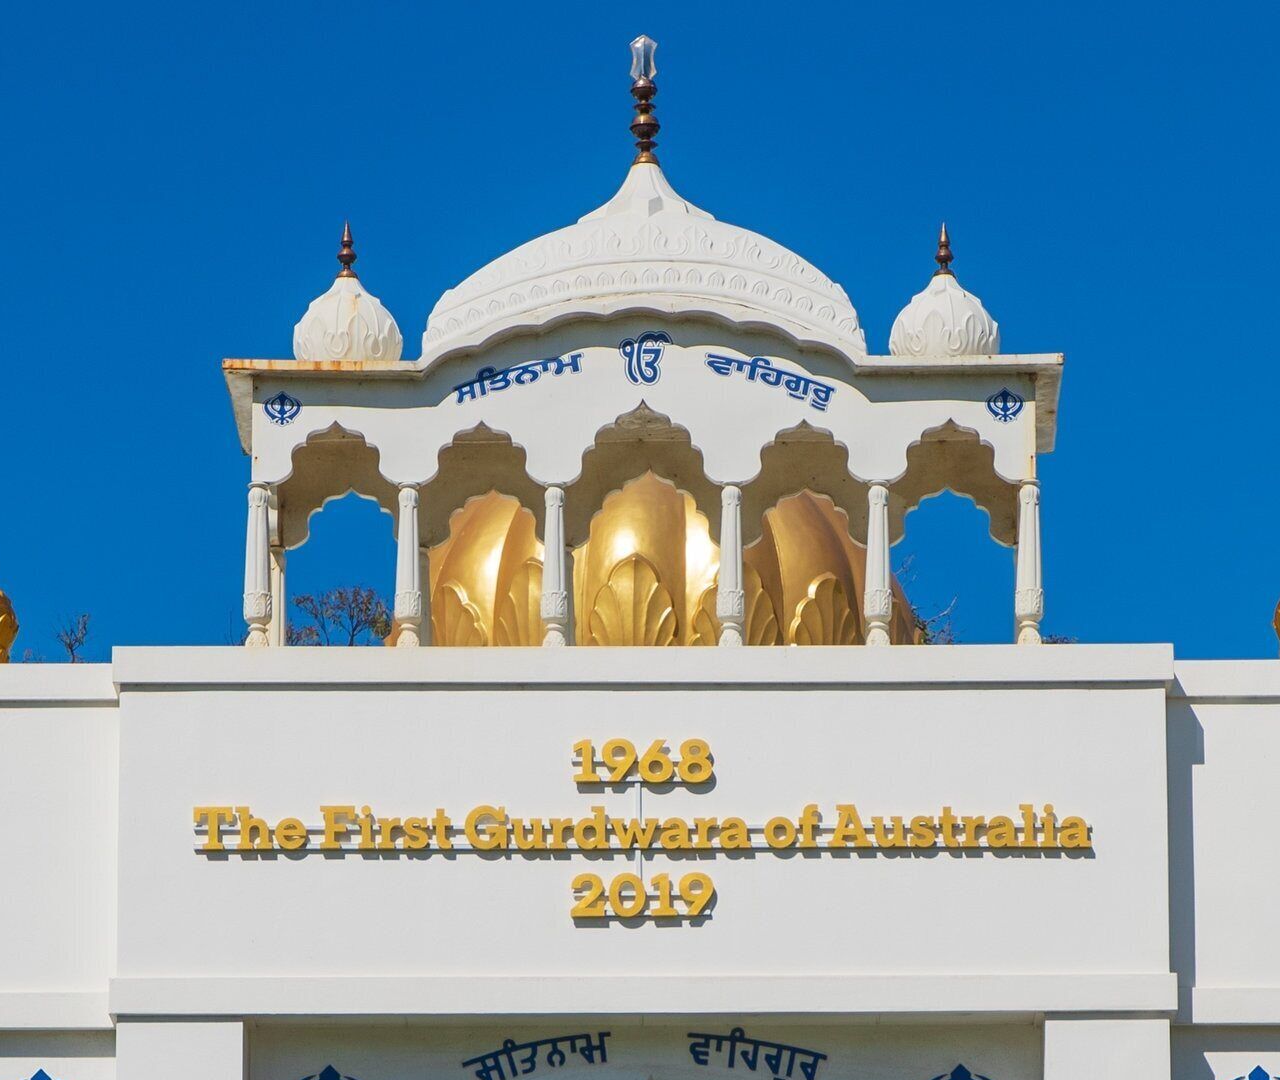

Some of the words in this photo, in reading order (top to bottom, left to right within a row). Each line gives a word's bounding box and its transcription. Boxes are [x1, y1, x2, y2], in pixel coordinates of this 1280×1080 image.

[454, 353, 584, 404] ਸਤਿਨਾਮ
[705, 353, 834, 411] ਵਾਹਿਗੁਰੂ
[572, 738, 713, 783] 1968
[193, 806, 307, 850] The
[320, 805, 452, 850] First
[464, 804, 751, 850] Gurdwara
[763, 803, 819, 848] of
[828, 803, 1092, 848] Australia
[570, 872, 714, 918] 2019
